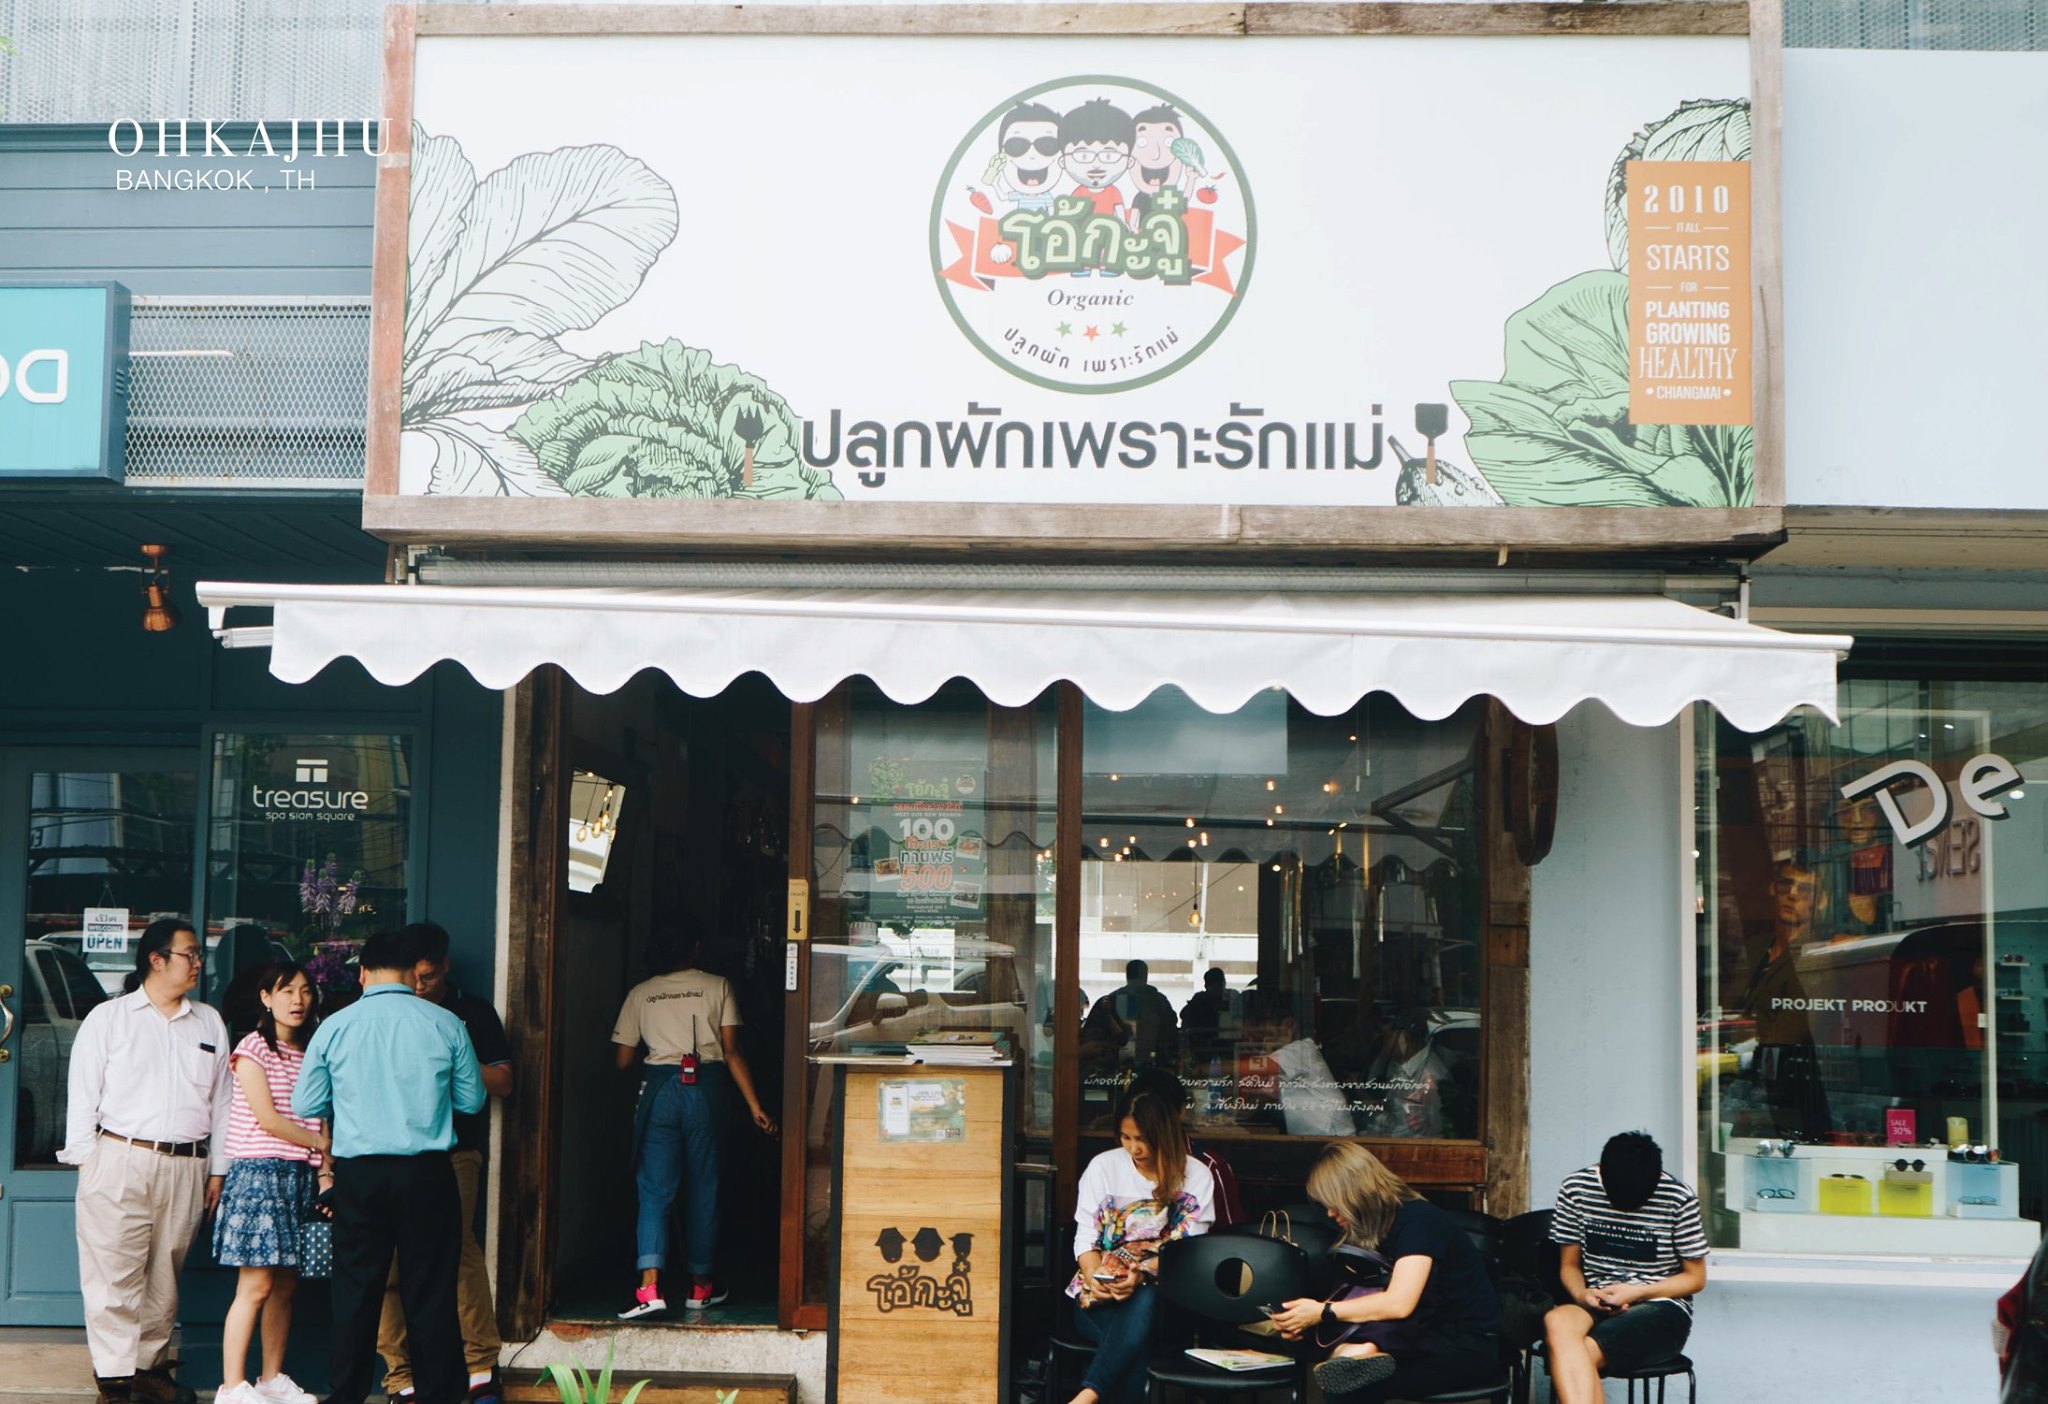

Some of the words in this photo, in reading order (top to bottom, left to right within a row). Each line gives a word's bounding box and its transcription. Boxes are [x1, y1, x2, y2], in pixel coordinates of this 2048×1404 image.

[1643, 185, 1729, 213] 2010
[1685, 222, 1701, 232] ALL
[1646, 245, 1729, 271] STARTS
[1680, 282, 1697, 292] FOR
[1047, 288, 1134, 311] Organic
[1645, 301, 1729, 319] PLANTING
[1645, 322, 1730, 344] GROWING
[1639, 347, 1737, 379] HEALTHY
[1656, 386, 1721, 400] CHIANGMAI
[802, 402, 1384, 488] ปลูกผักเพราะรักแม่
[253, 785, 368, 809] treasure
[1840, 753, 2025, 848] De
[265, 811, 286, 822] spa
[289, 811, 313, 820] siam
[317, 812, 355, 823] square
[899, 818, 954, 841] 100
[900, 864, 953, 890] 500
[87, 934, 123, 949] OPEN
[1771, 998, 1846, 1011] PROJEKT
[1852, 999, 1927, 1013] PRODUKT
[1890, 1119, 1907, 1127] SALE
[1891, 1127, 1912, 1136] 30%
